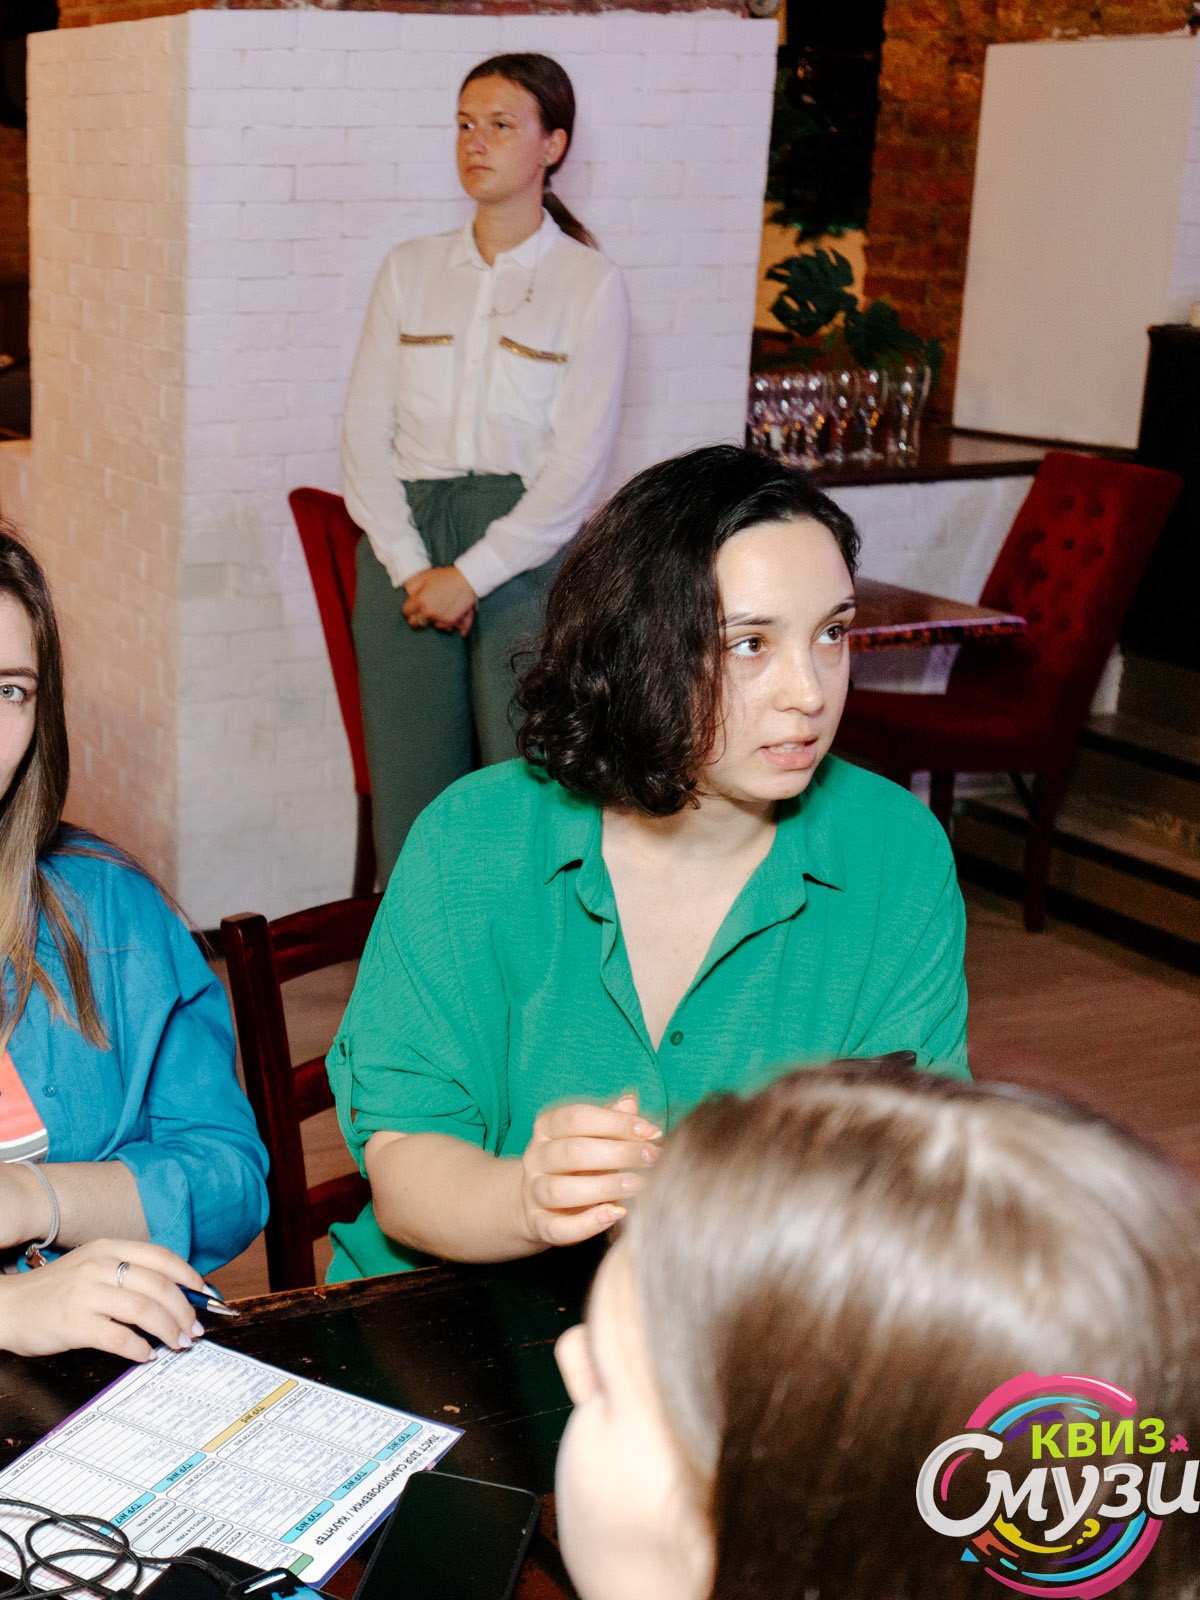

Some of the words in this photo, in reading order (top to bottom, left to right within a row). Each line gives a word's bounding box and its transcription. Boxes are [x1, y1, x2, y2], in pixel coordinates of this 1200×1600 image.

[250, 1406, 265, 1414] ТУР
[395, 1432, 411, 1442] ТУР
[416, 1434, 440, 1451] ЛИСТ
[401, 1450, 422, 1464] ДЛЯ
[177, 1462, 193, 1472] ТУР
[352, 1470, 367, 1480] ТУР
[348, 1463, 408, 1512] САМОПРОВЕРКИ
[124, 1503, 142, 1513] ТУР
[305, 1511, 321, 1521] ТУР
[312, 1515, 350, 1545] КАУНТЕР
